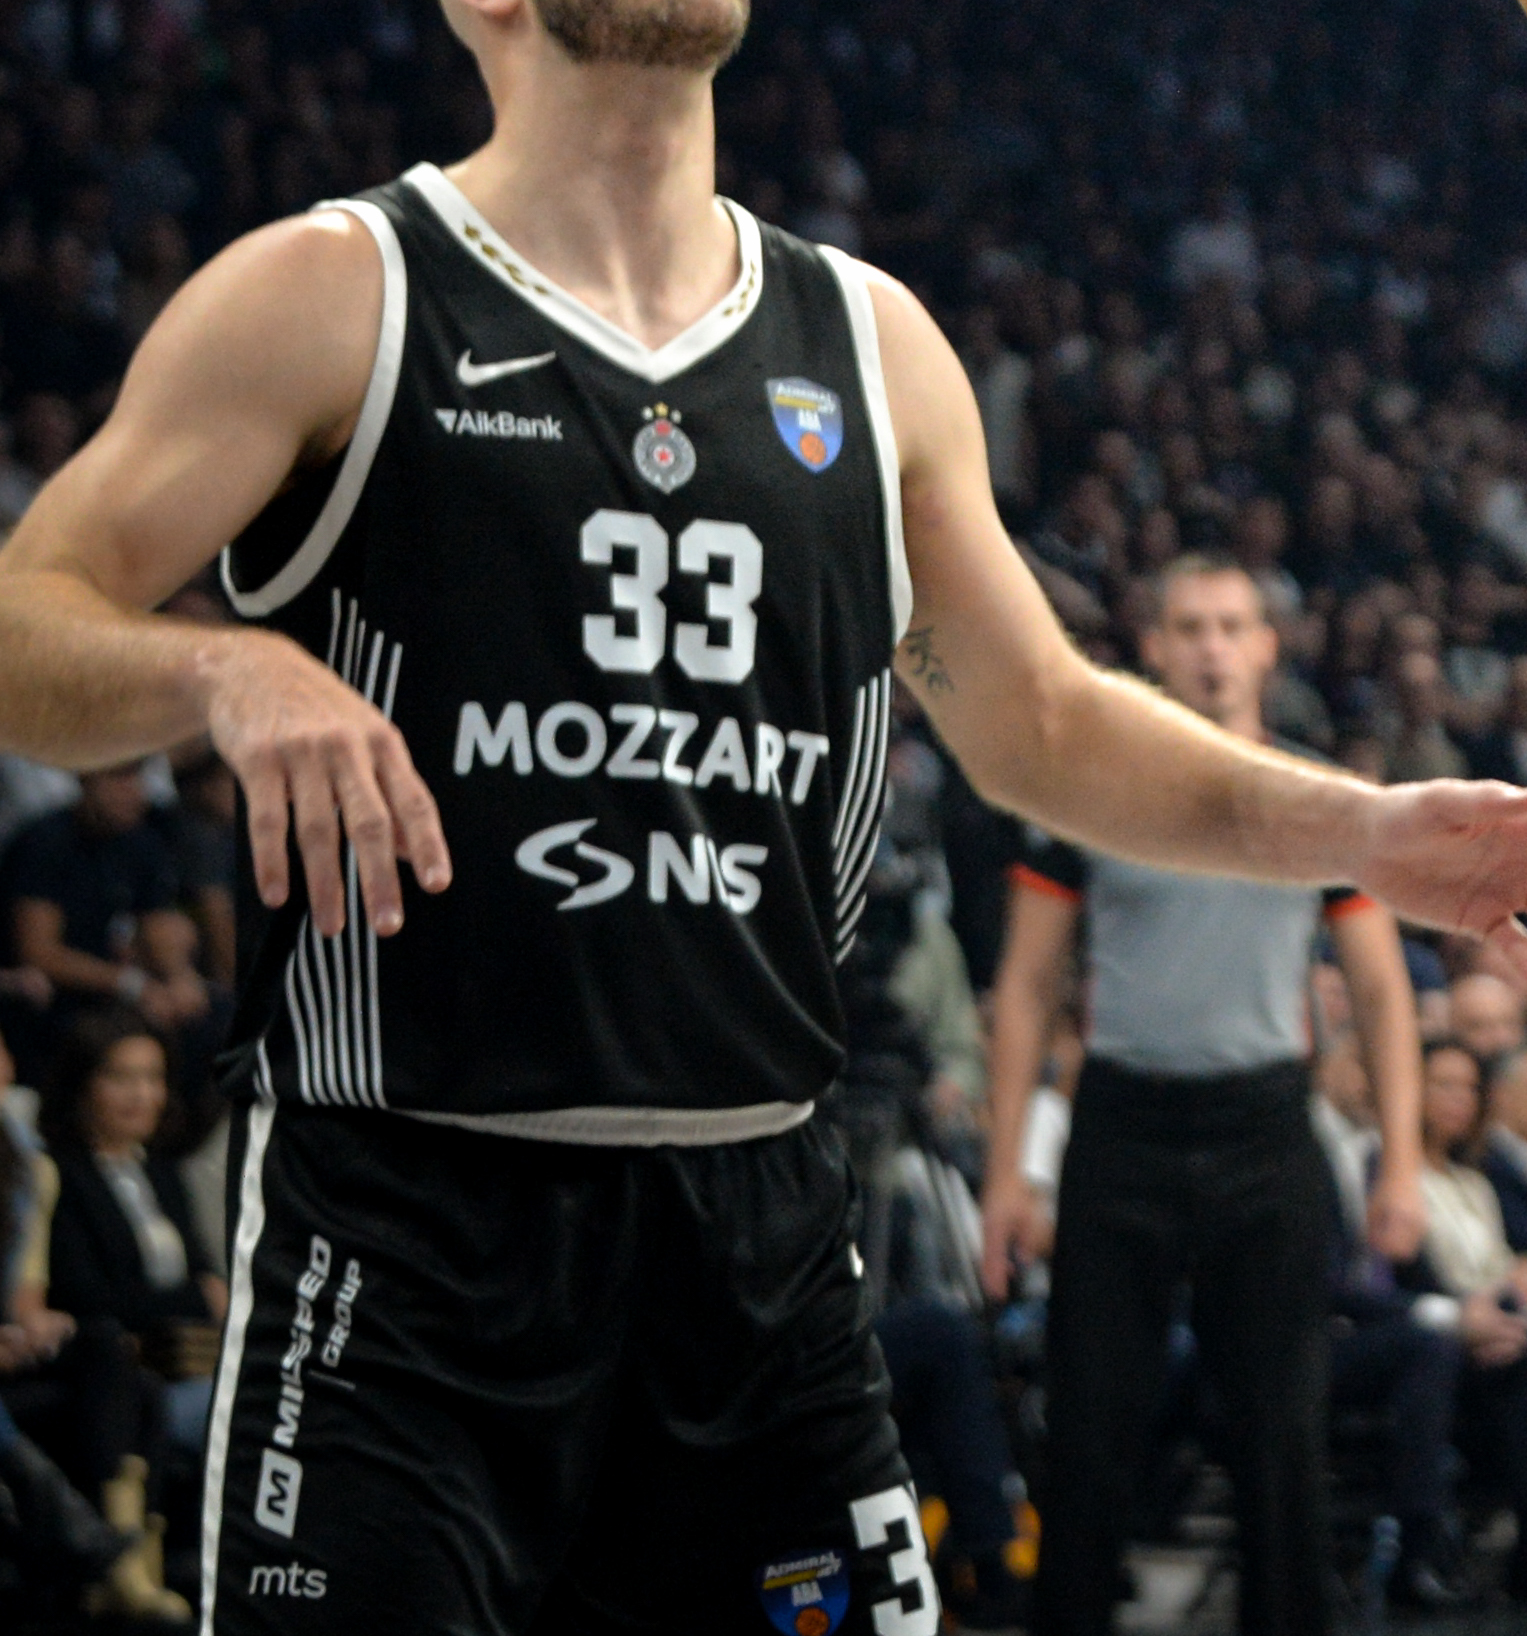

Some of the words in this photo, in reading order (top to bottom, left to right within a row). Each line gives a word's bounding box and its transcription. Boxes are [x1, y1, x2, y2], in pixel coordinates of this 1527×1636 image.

[456, 407, 563, 441] AikBank
[580, 509, 763, 684] 33
[453, 700, 830, 806] MOZZART
[321, 1257, 363, 1368] GROUP
[248, 1561, 328, 1599] mts
[849, 1479, 942, 1636] 3
